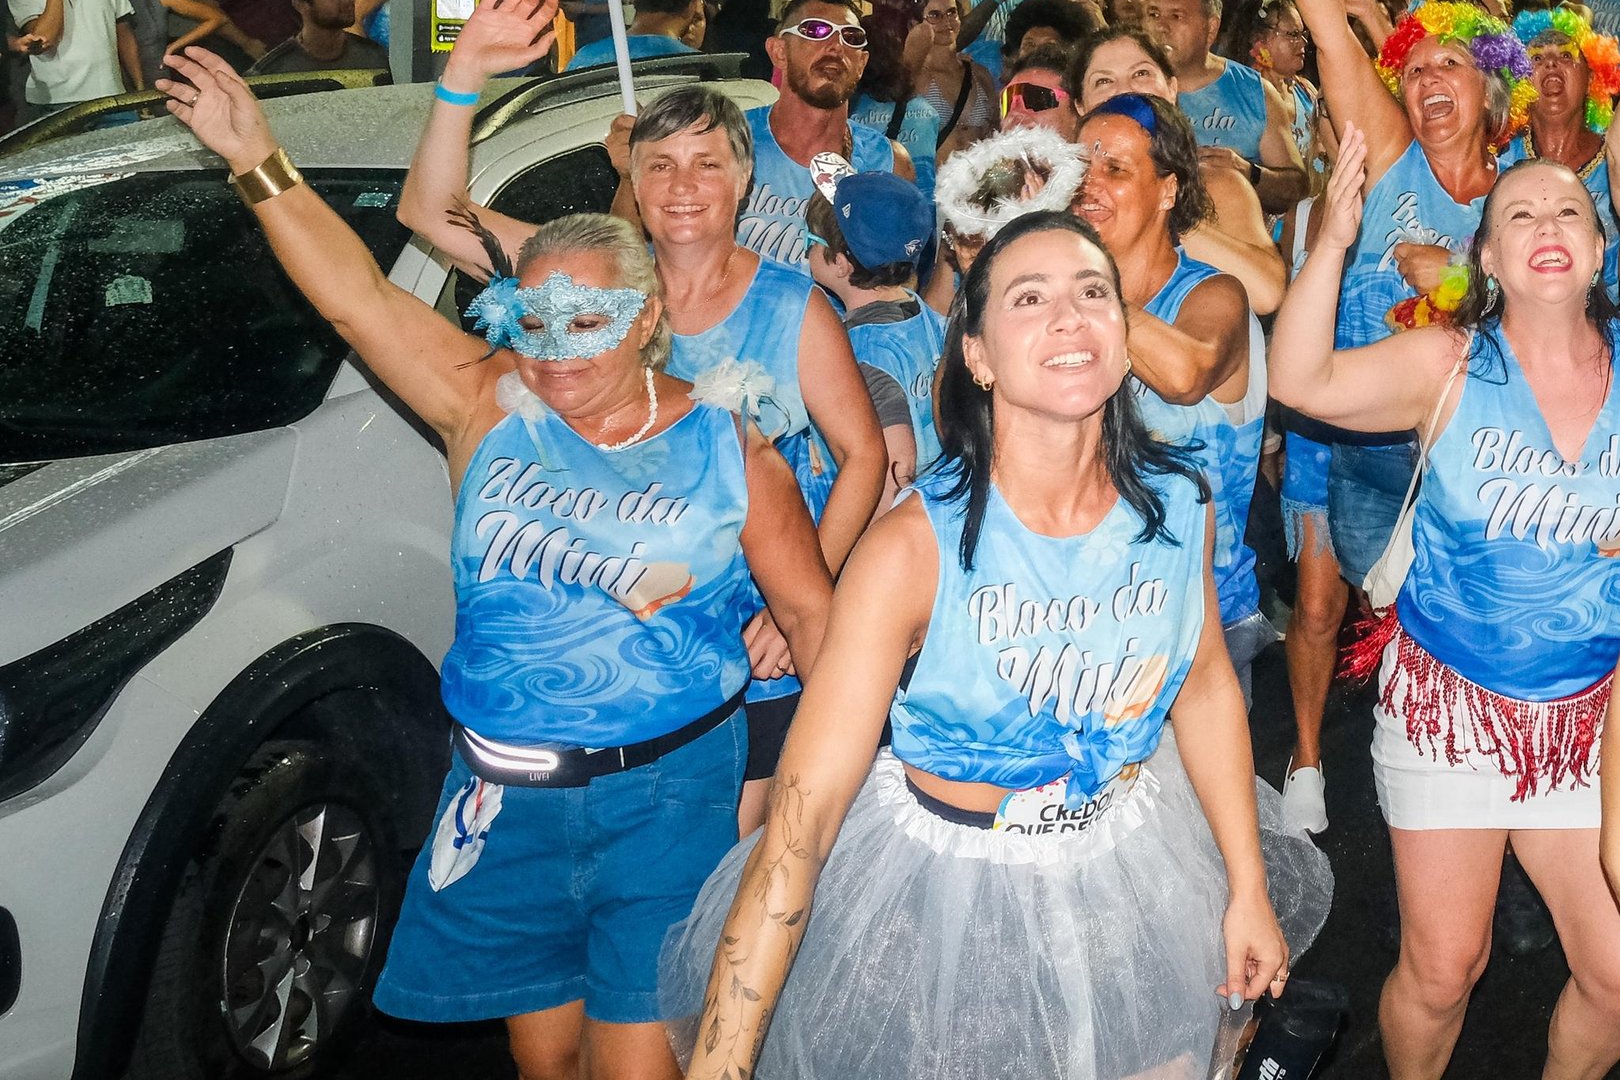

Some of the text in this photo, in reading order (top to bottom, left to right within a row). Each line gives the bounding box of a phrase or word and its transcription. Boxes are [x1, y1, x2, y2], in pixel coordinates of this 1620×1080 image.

[1471, 426, 1590, 479] Bloco
[478, 456, 690, 527] Bloco da
[475, 510, 648, 597] Mini
[967, 561, 1169, 647] Bloco da
[530, 772, 550, 781] LIVE!
